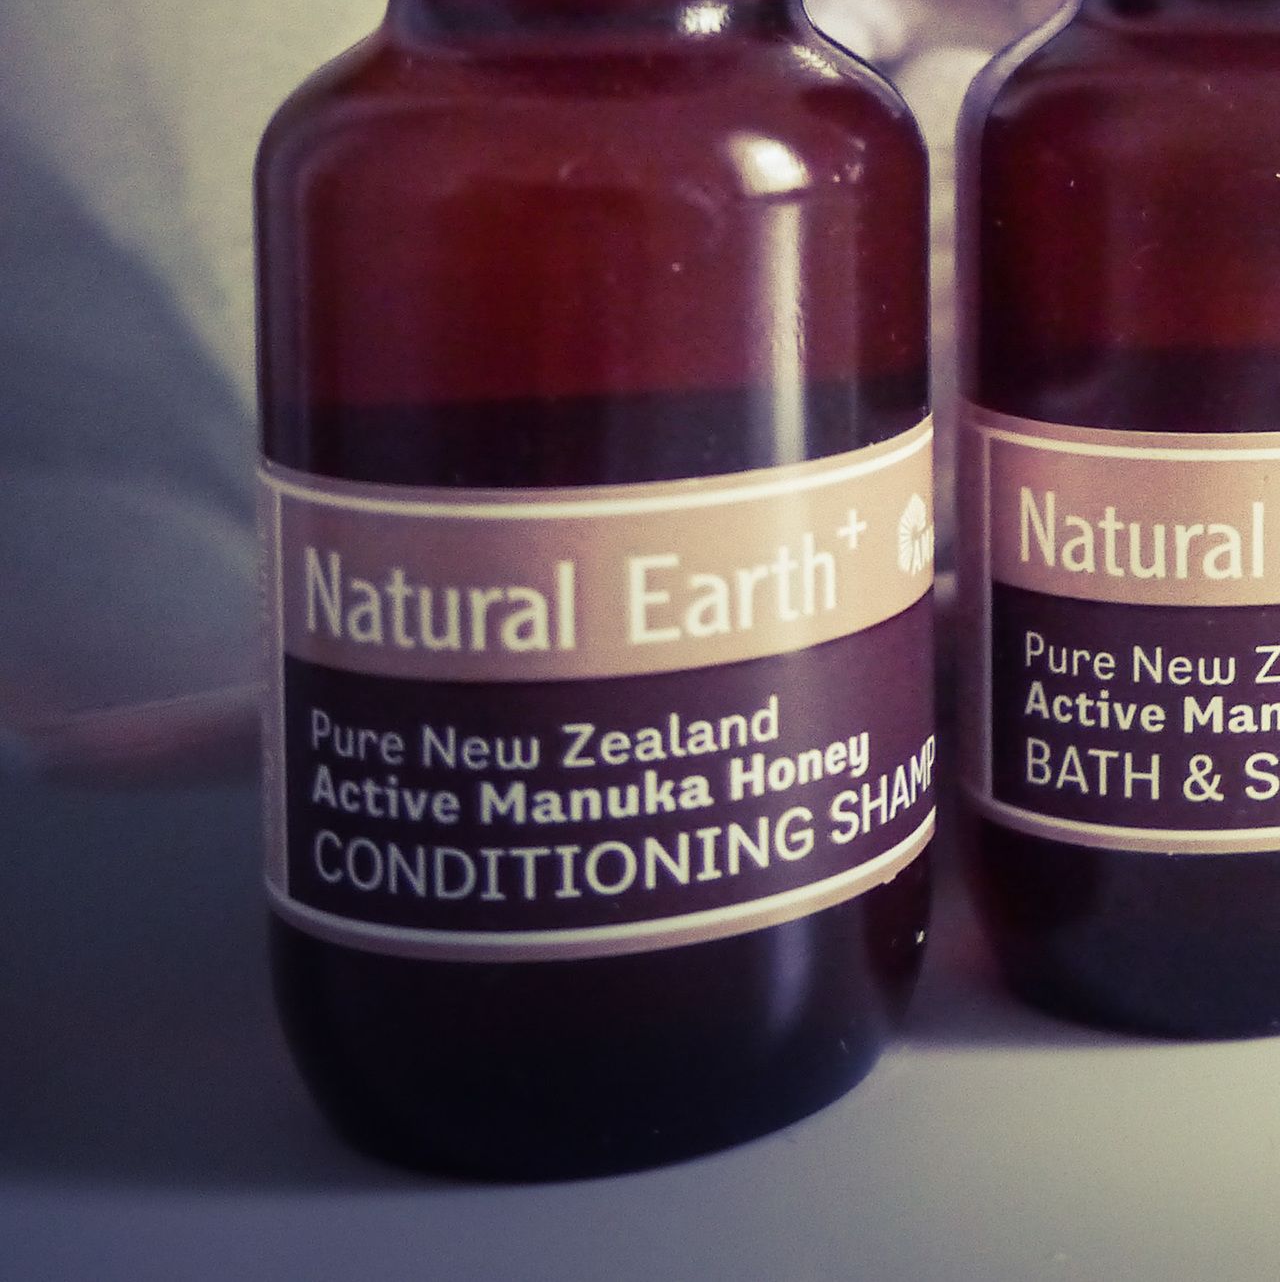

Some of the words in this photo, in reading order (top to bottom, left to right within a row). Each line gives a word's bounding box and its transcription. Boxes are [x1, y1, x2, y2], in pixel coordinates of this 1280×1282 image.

[1018, 485, 1265, 580] Natural
[302, 546, 576, 652] Natural
[1024, 631, 1115, 680] Pure
[1132, 644, 1236, 684] New
[310, 709, 405, 762] Pure
[422, 726, 540, 771] New
[560, 695, 781, 770] Zealand
[1024, 681, 1167, 733] Active
[311, 766, 460, 825] Active
[479, 771, 714, 824] Manuka
[729, 731, 871, 802] Honey
[1025, 737, 1161, 800] BATH
[1182, 753, 1225, 802] &
[314, 804, 815, 902] CONDITIONING
